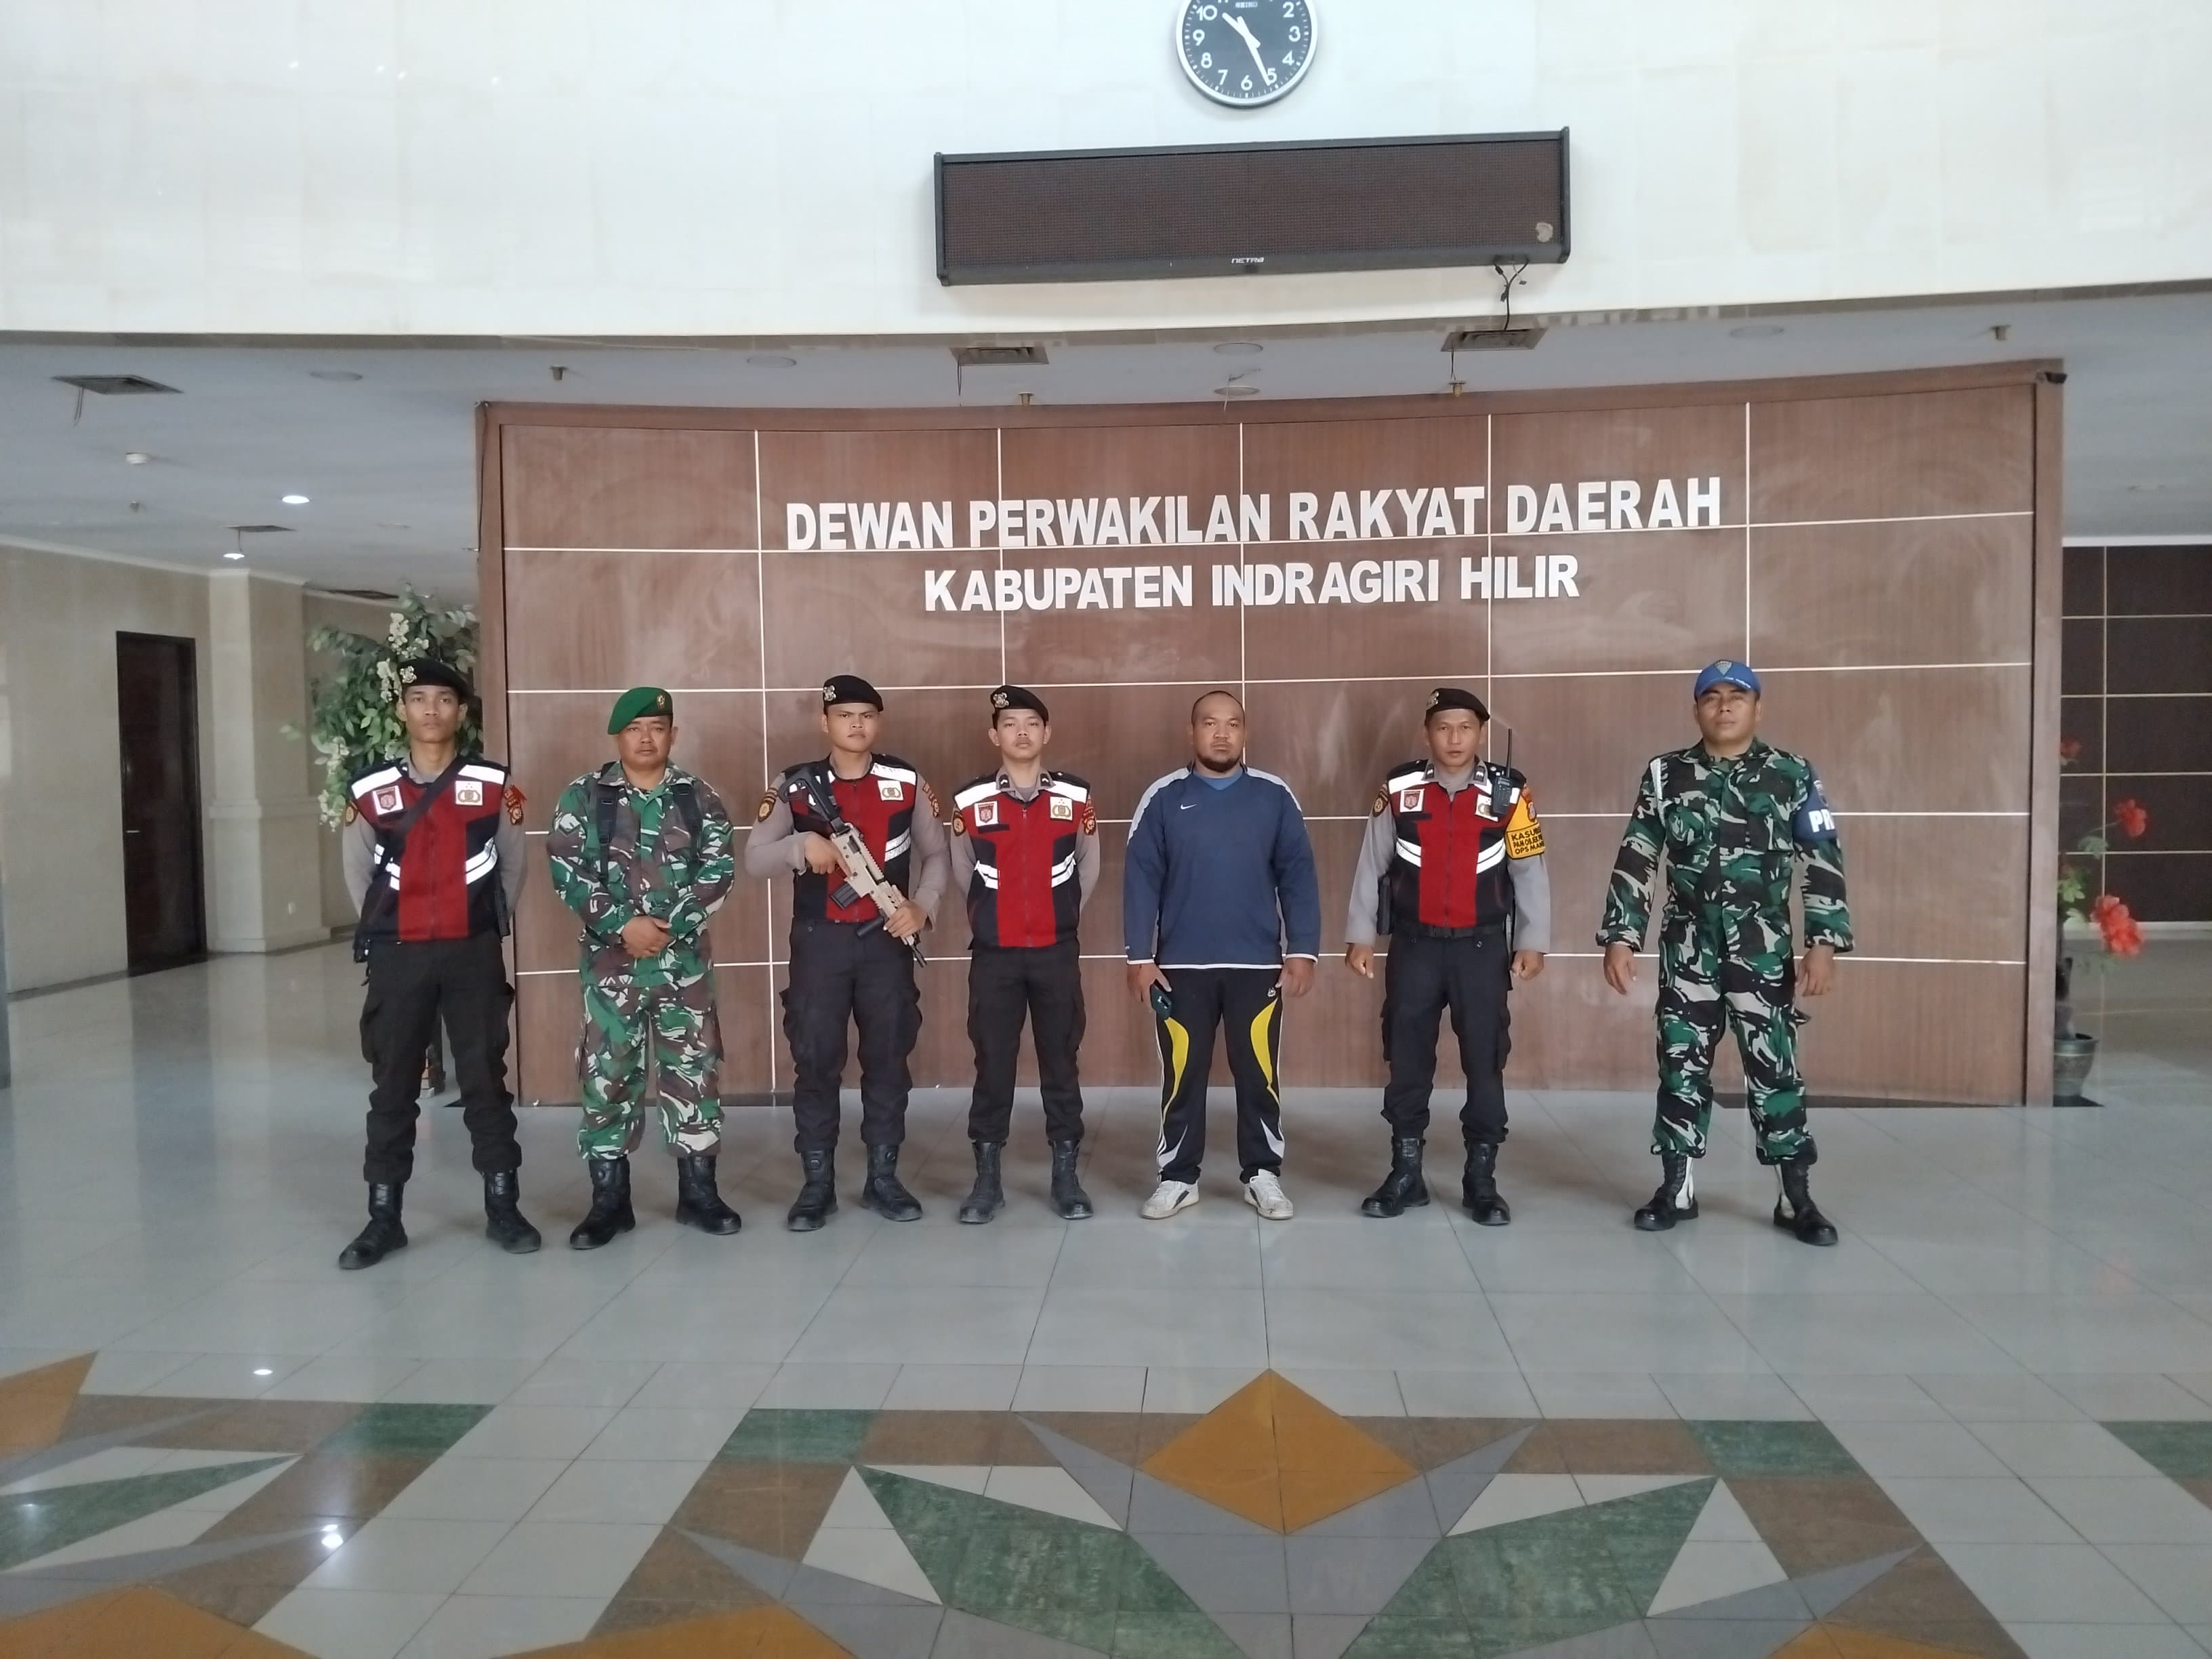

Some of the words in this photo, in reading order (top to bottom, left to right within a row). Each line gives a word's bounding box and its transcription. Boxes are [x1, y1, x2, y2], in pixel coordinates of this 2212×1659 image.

[1196, 5, 1217, 20] 10
[1282, 2, 1294, 18] 2
[1193, 29, 1205, 45] 9
[1288, 26, 1300, 42] 3
[1201, 52, 1212, 68] 8
[1282, 50, 1294, 66] 4
[1218, 69, 1228, 85] 7
[1241, 75, 1252, 91] 6
[1267, 68, 1277, 83] 5
[786, 501, 954, 550] DEWAN
[970, 494, 1271, 548] PERWAKILAN
[1290, 486, 1485, 540] RAKYAT
[1507, 476, 1721, 534] DAERAH
[924, 565, 1193, 611] KABUPATEN
[1212, 558, 1439, 607] INDRAGIRI
[1460, 554, 1580, 600] HILIR
[1515, 846, 1529, 855] OPS
